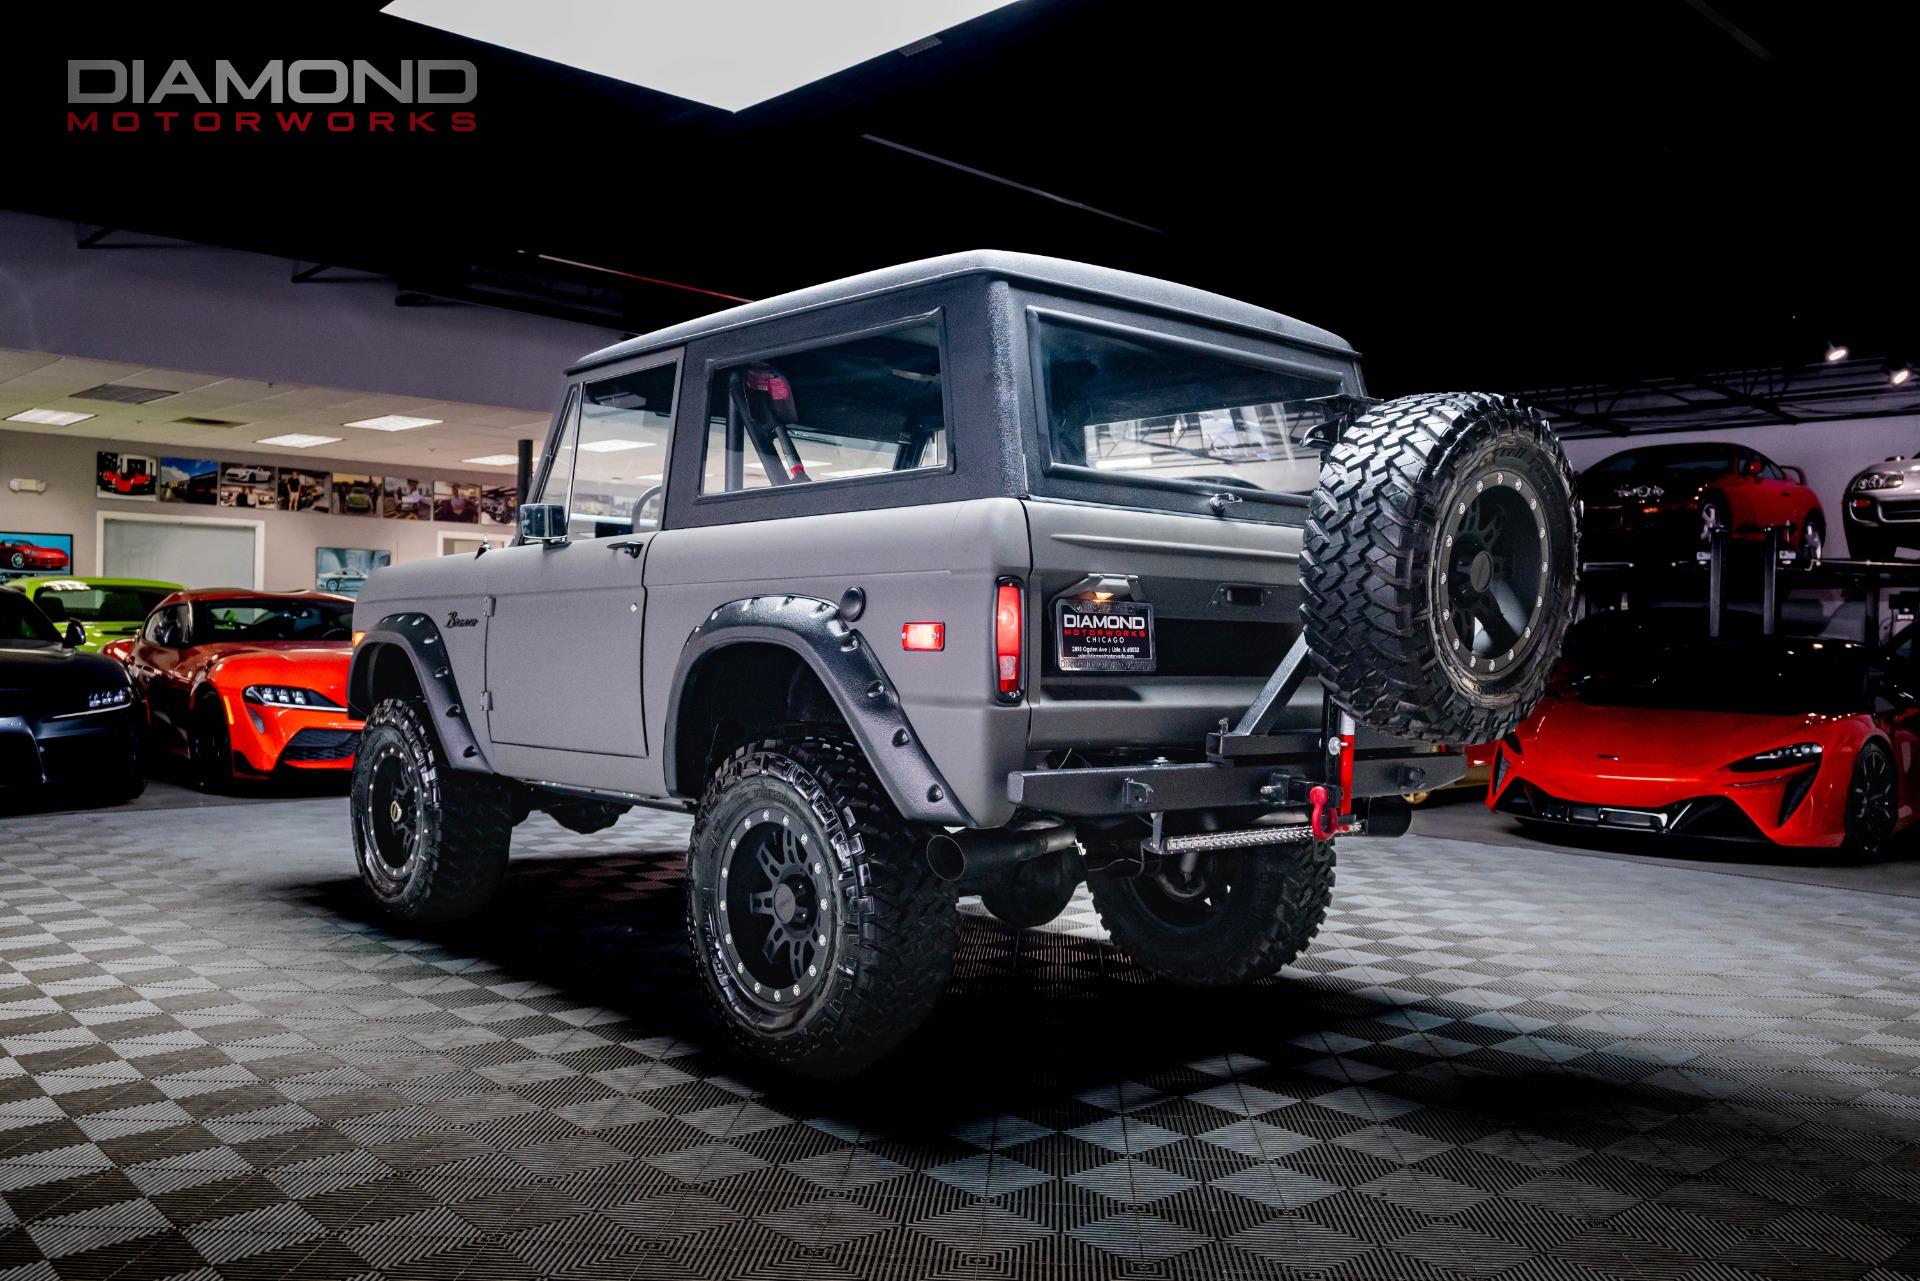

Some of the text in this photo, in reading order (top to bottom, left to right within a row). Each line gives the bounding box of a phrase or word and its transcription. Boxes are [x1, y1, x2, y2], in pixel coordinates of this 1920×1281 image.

[1063, 614, 1145, 629] DIAMOND
[1063, 629, 1146, 638] MOTORWORKS
[1082, 646, 1098, 654] Ogden
